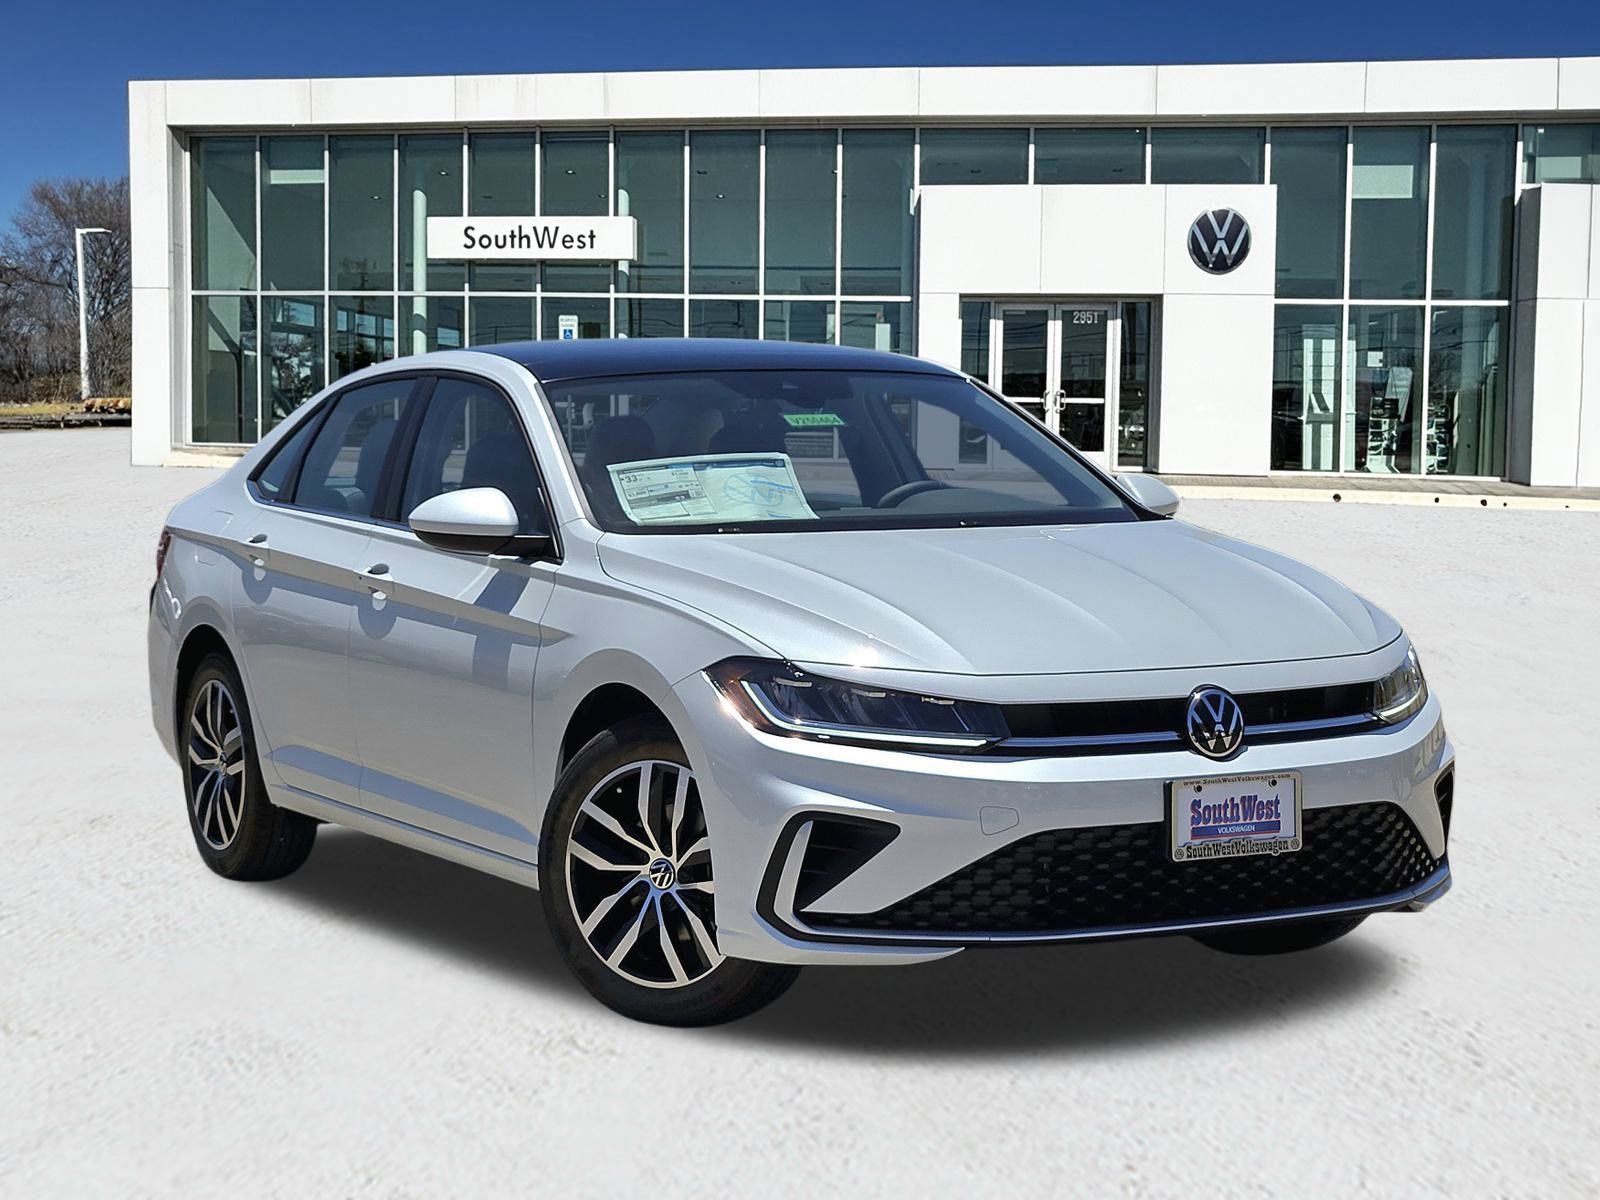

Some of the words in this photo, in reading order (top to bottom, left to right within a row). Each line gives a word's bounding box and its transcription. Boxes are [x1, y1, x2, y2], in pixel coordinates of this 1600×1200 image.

[463, 225, 596, 249] SouthWest
[1073, 311, 1098, 324] 2951
[1190, 793, 1281, 826] SouthWest
[1217, 824, 1256, 834] VOLKSWAGEN
